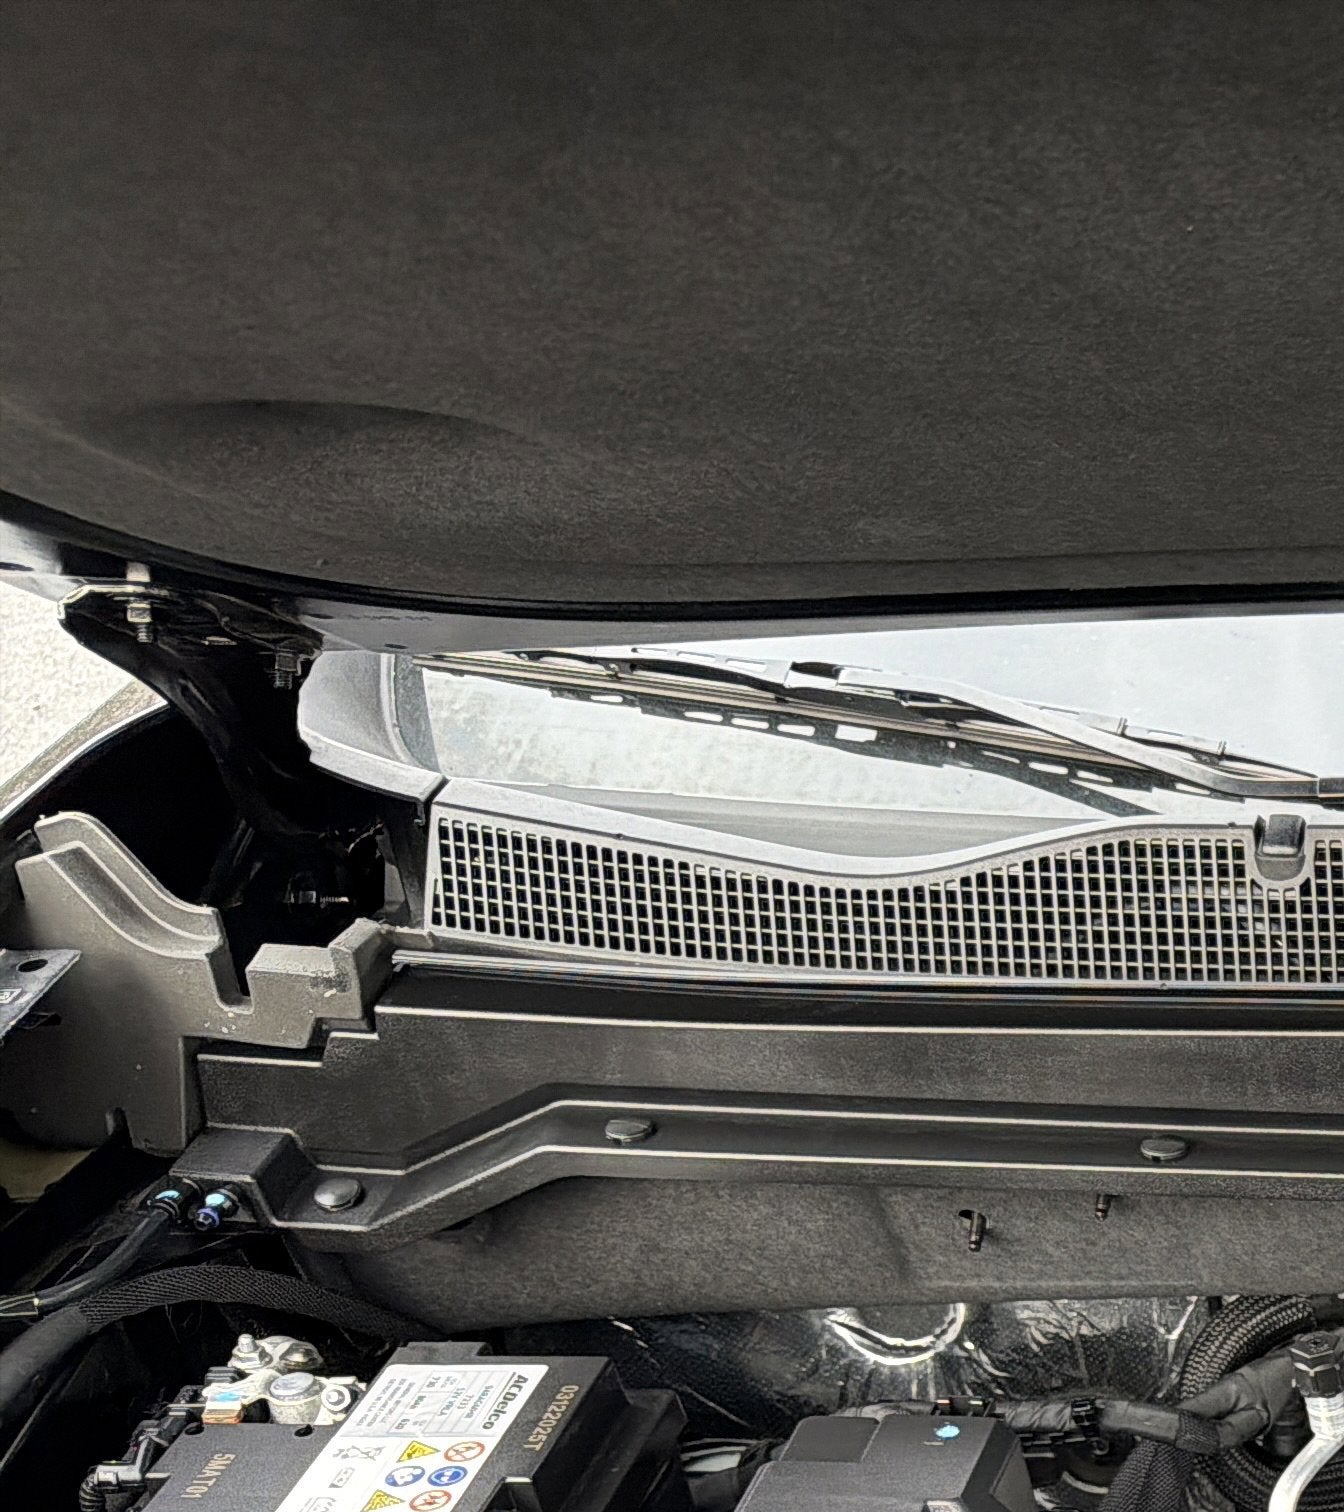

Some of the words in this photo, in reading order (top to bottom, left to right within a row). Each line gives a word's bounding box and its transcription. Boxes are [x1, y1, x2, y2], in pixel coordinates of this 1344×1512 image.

[482, 1373, 529, 1430] ACDelco
[523, 1384, 580, 1451] 03122025T
[180, 1453, 237, 1498] 5MAT01
